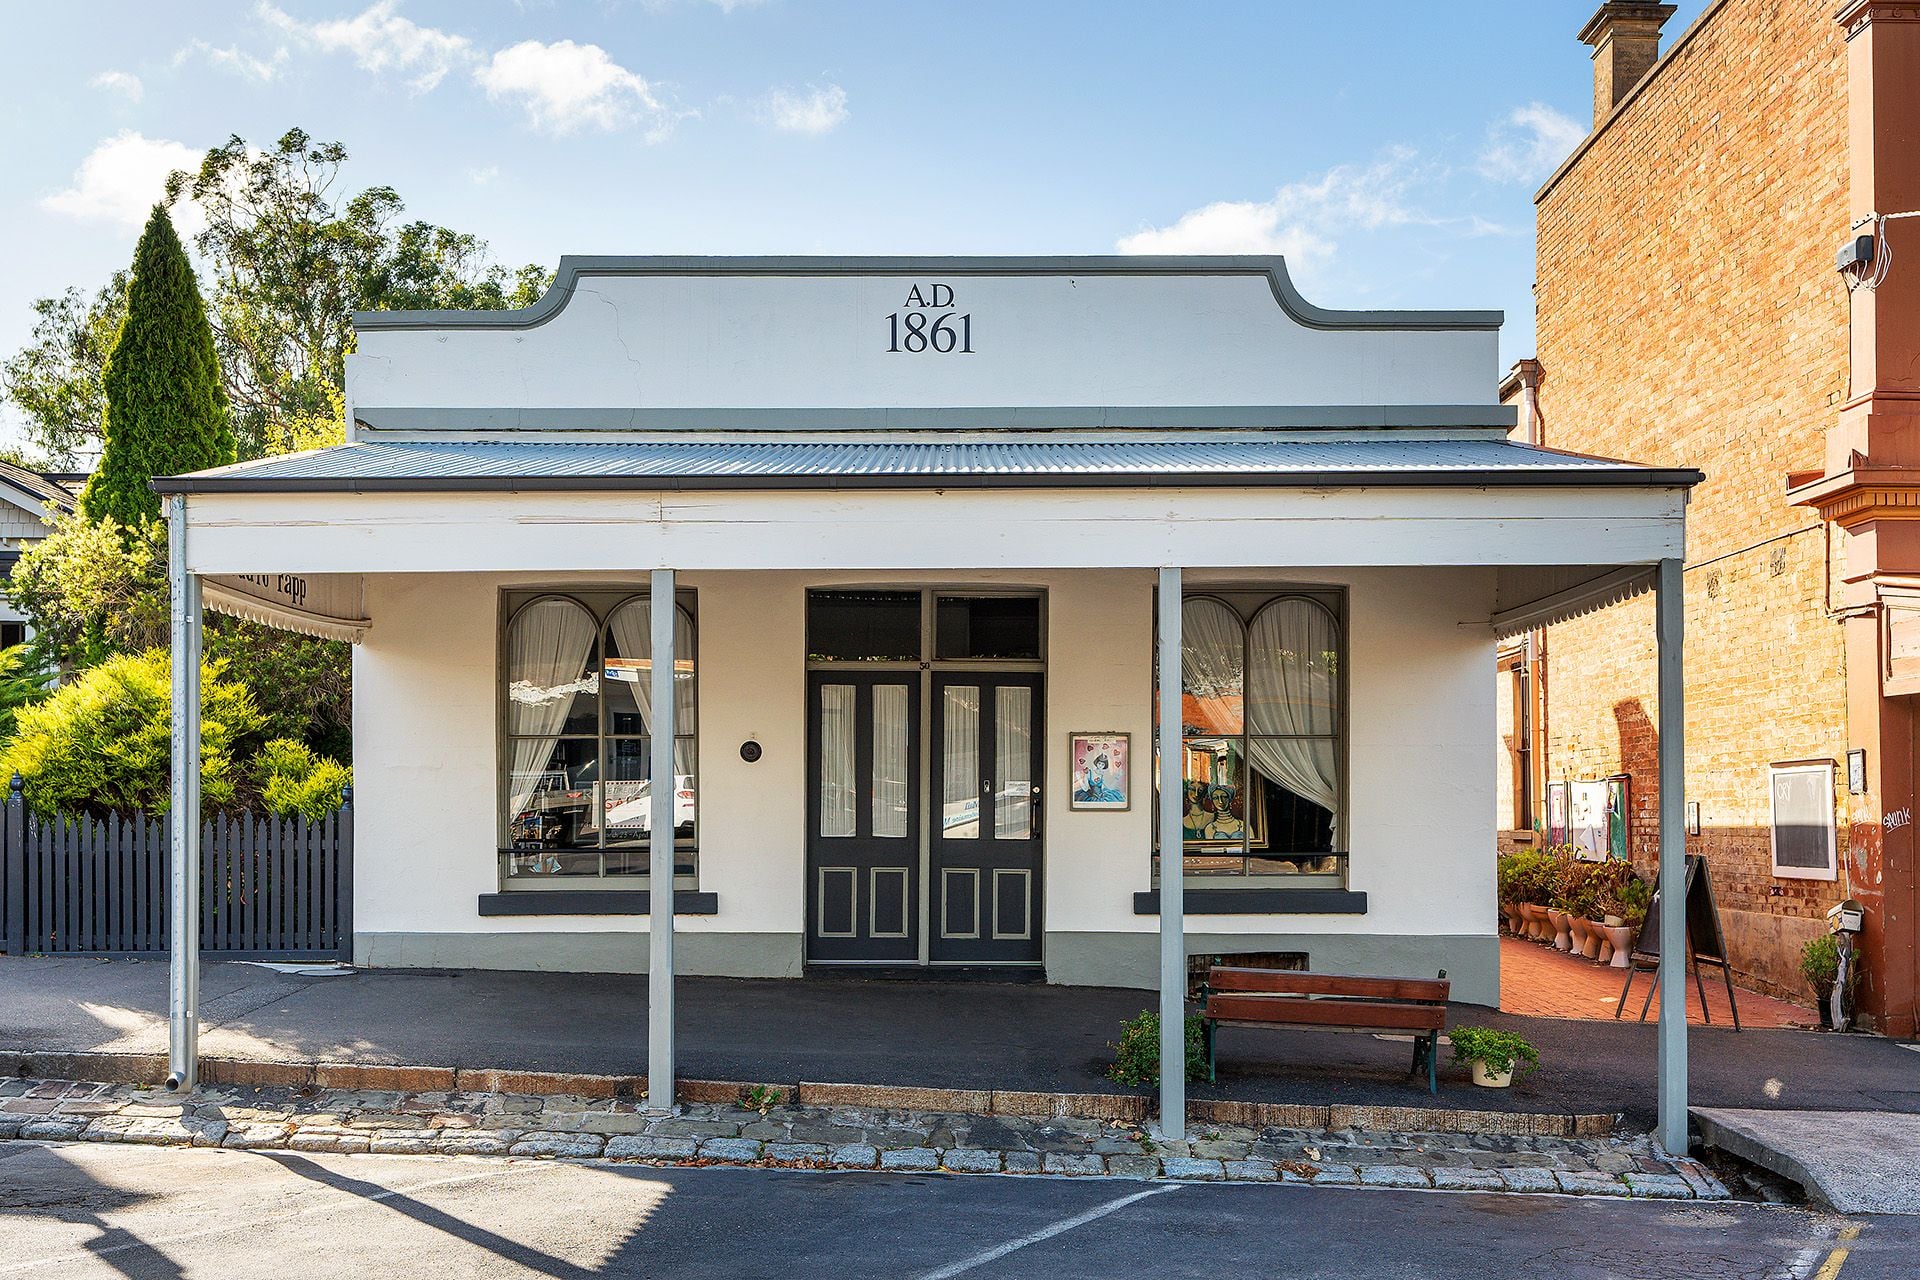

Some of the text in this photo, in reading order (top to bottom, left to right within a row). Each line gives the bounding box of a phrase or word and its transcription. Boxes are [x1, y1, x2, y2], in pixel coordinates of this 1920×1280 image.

[903, 283, 955, 308] A.D.
[885, 312, 976, 354] 1861
[919, 661, 930, 670] 50
